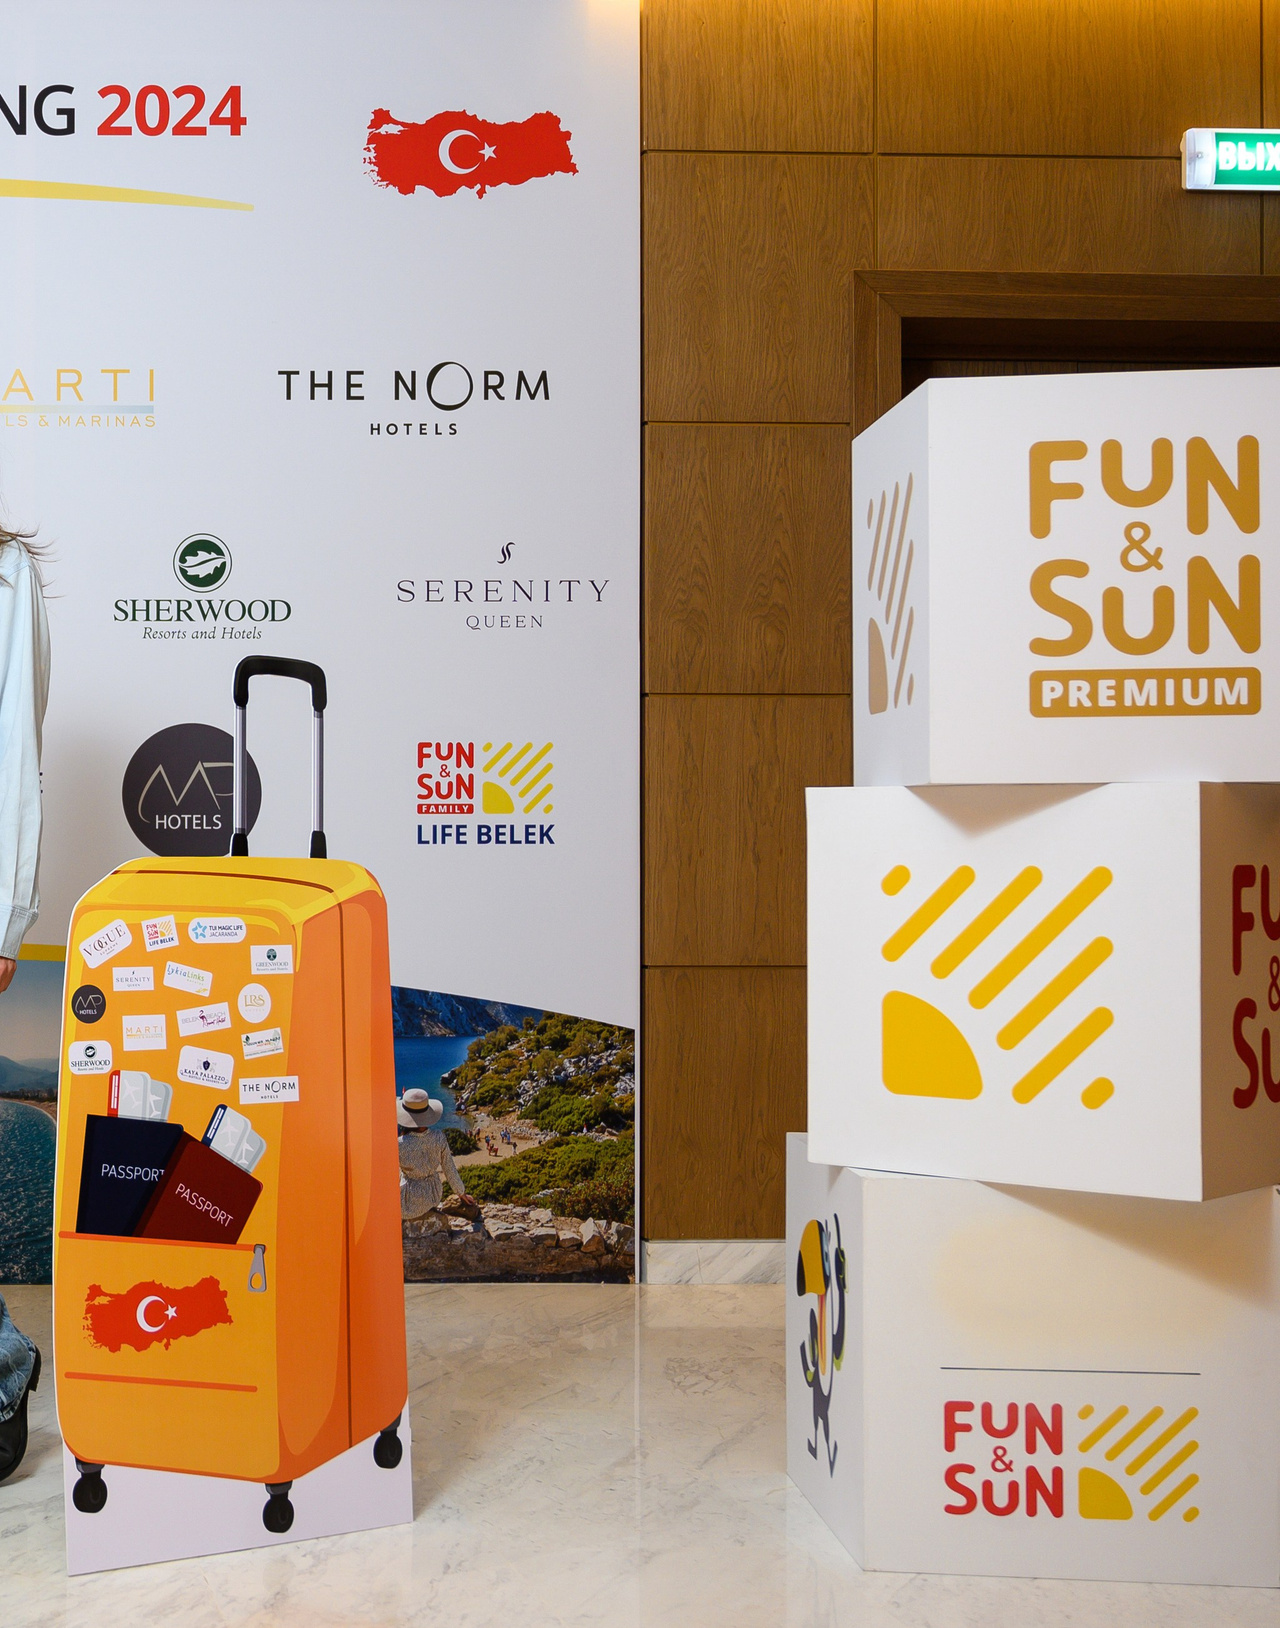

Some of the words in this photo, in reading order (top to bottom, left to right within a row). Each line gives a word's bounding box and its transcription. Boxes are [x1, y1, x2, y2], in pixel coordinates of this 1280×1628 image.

[96, 84, 248, 136] 2024
[1218, 141, 1280, 171] ВЫХ
[278, 370, 365, 400] THE
[394, 361, 550, 411] NORM
[38, 416, 49, 427] &
[58, 415, 156, 427] MARINAS
[370, 423, 458, 435] HOTELS
[1029, 435, 1260, 539] FUN
[1120, 521, 1164, 572] &
[397, 580, 609, 602] SERENITY
[113, 599, 292, 622] SHERWOOD
[1029, 554, 1261, 657] SUN
[142, 626, 186, 639] Resorts
[191, 626, 216, 639] and
[221, 626, 262, 639] Hotels
[466, 615, 543, 630] QUEEN
[1042, 677, 1249, 708] PREMIUM
[417, 742, 474, 768] FUN
[439, 764, 451, 778] &
[417, 773, 474, 800] SUN
[155, 814, 222, 829] HOTELS
[422, 804, 469, 813] FAMILY
[417, 824, 467, 844] LIFE
[477, 824, 555, 844] BELEK
[1232, 864, 1280, 977] FU
[83, 924, 126, 956] VOGUE
[126, 1026, 163, 1034] MARTI
[70, 1059, 111, 1067] SHERWOOD
[1232, 997, 1280, 1109] SU
[184, 1068, 199, 1077] KAYA
[200, 1072, 226, 1082] PALAZZO
[243, 1084, 260, 1092] THE
[265, 1080, 296, 1093] NORM
[175, 1183, 234, 1227] PASSPORT
[943, 1400, 1063, 1455] FUN
[990, 1445, 1014, 1473] &
[943, 1463, 1063, 1518] SUN
